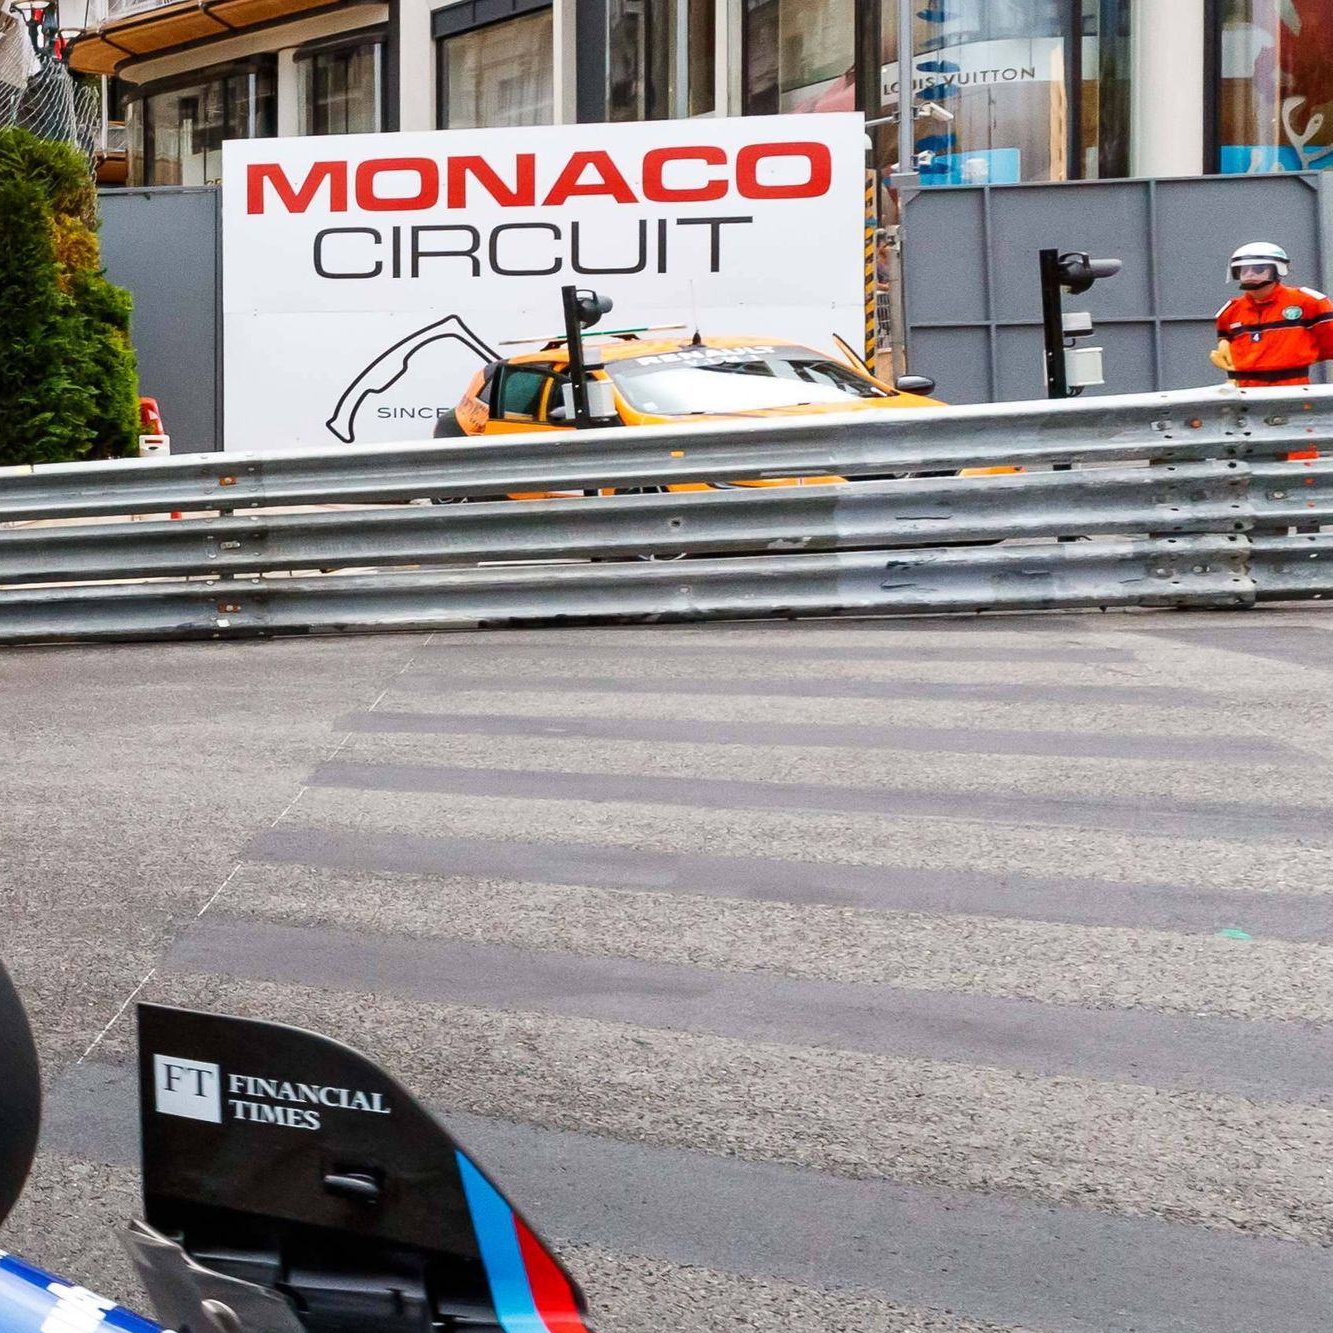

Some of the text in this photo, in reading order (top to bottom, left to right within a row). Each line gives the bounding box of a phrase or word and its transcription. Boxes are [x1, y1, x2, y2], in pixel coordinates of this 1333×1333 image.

[943, 67, 1035, 86] VUITTON
[246, 141, 831, 215] MONACO
[313, 216, 753, 280] CIRCUIT
[636, 346, 775, 366] RENAULT
[162, 1063, 392, 1114] FT FINANCIAL
[228, 1099, 322, 1131] TIMES
